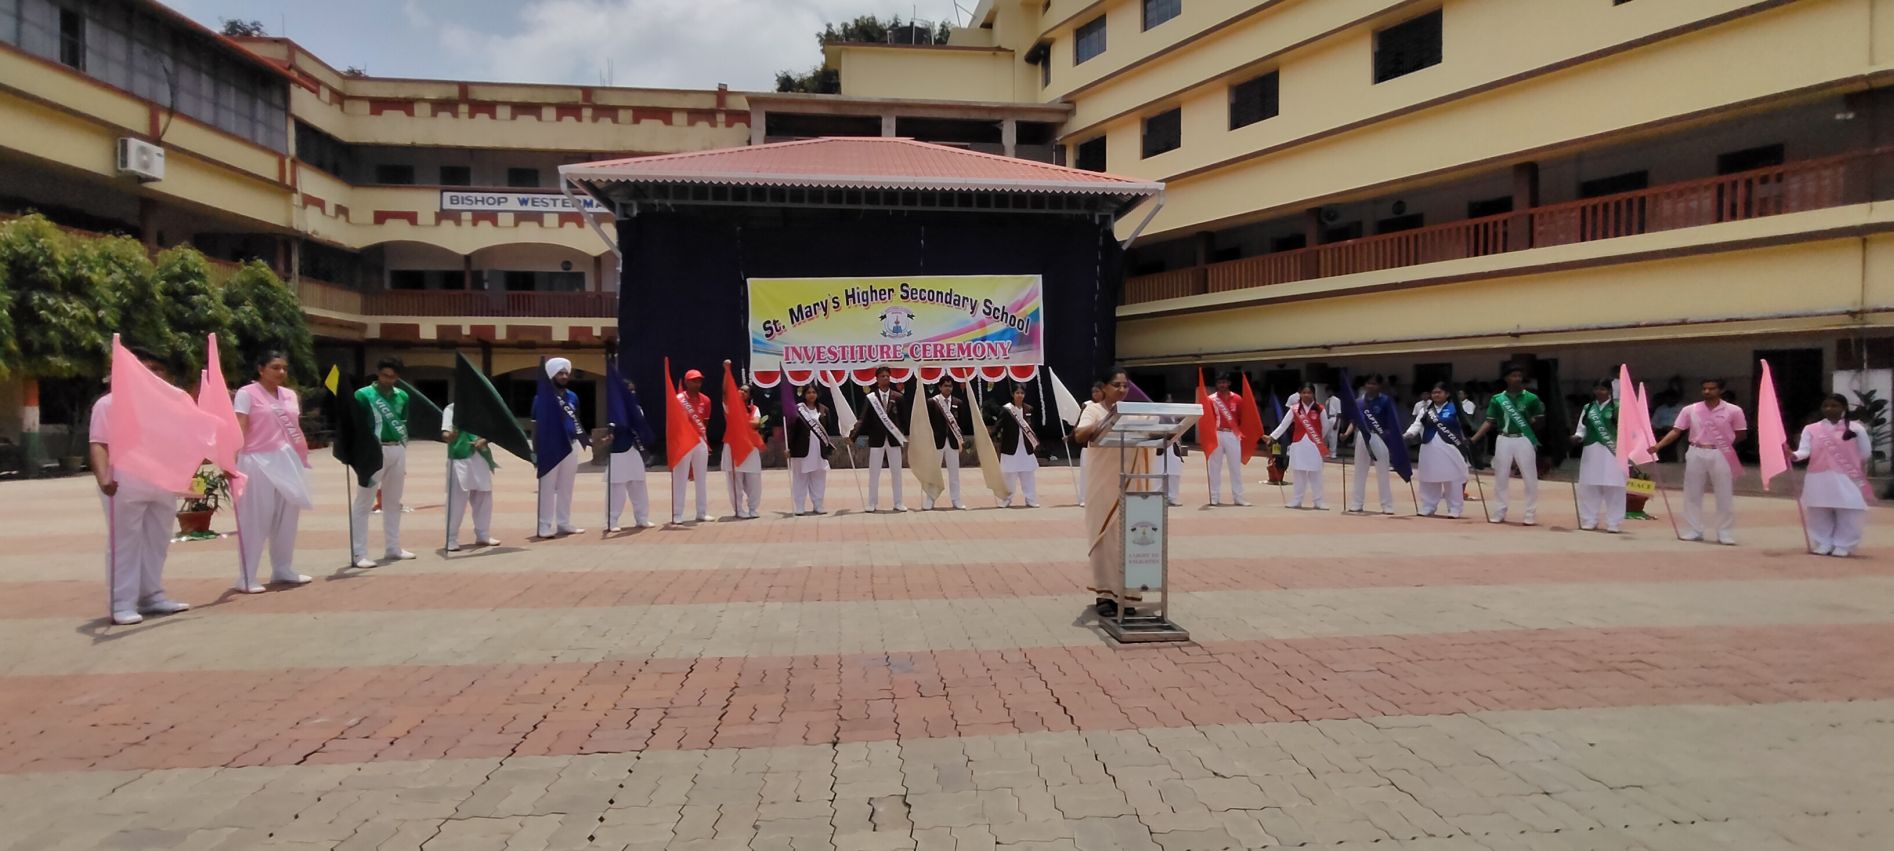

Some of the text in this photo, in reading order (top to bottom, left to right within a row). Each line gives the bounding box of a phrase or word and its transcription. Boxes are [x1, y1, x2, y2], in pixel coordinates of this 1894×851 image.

[449, 195, 508, 206] BISHOP
[763, 282, 1031, 338] St. Mary's Higher Secondary School
[784, 340, 1011, 363] INVESTITURE CEREMONY
[375, 398, 394, 419] VICE
[1502, 400, 1526, 428] CAPTAIN
[1363, 409, 1384, 434] CAPTAIN
[1437, 422, 1461, 446] CAPTAIN
